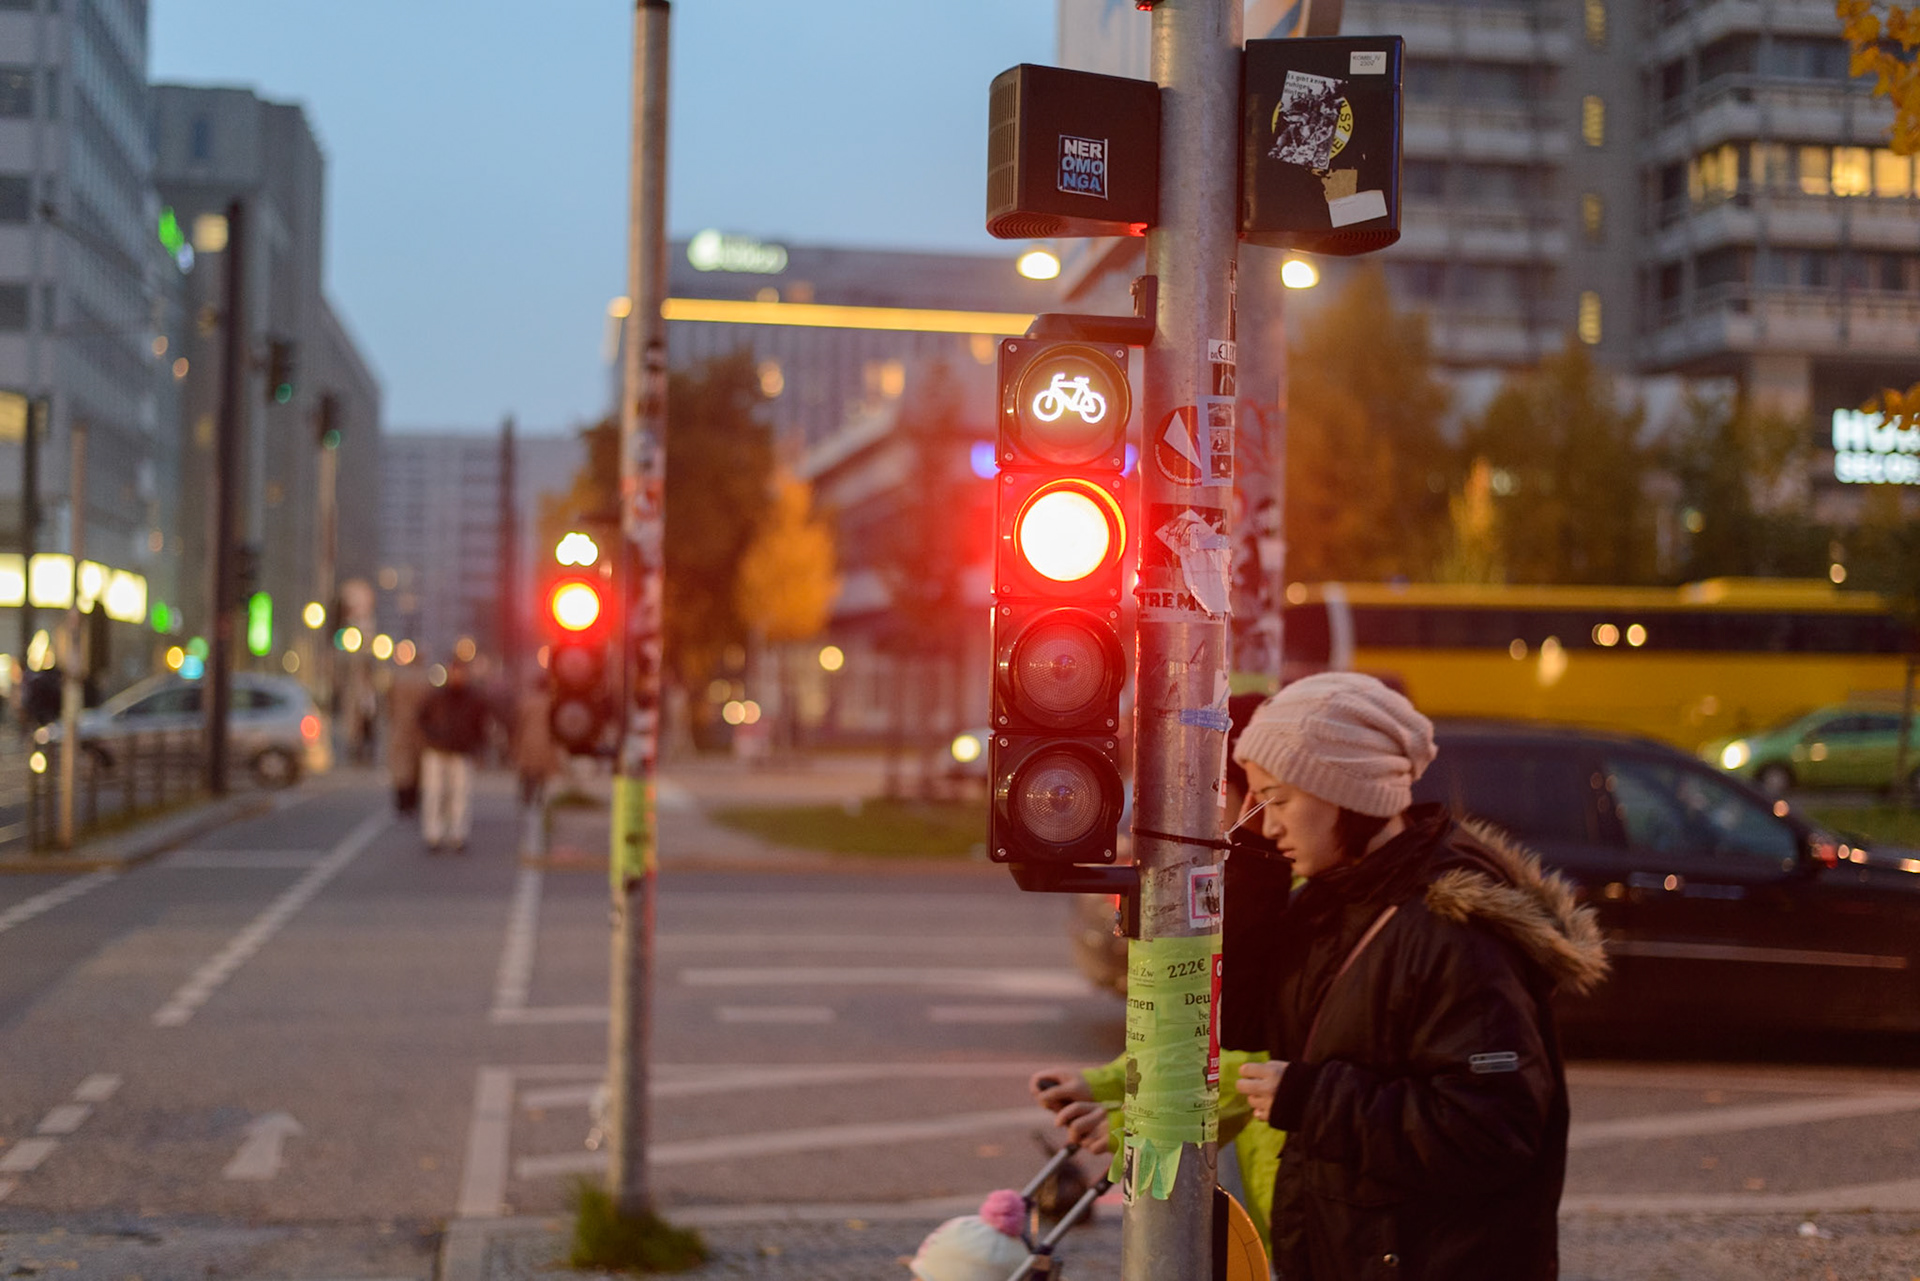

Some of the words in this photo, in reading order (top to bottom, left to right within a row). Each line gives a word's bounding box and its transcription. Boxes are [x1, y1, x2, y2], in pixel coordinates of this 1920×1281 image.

[1064, 140, 1102, 158] NER
[1062, 156, 1103, 175] OMO
[1063, 172, 1101, 191] NGA
[1167, 958, 1206, 979] 222€
